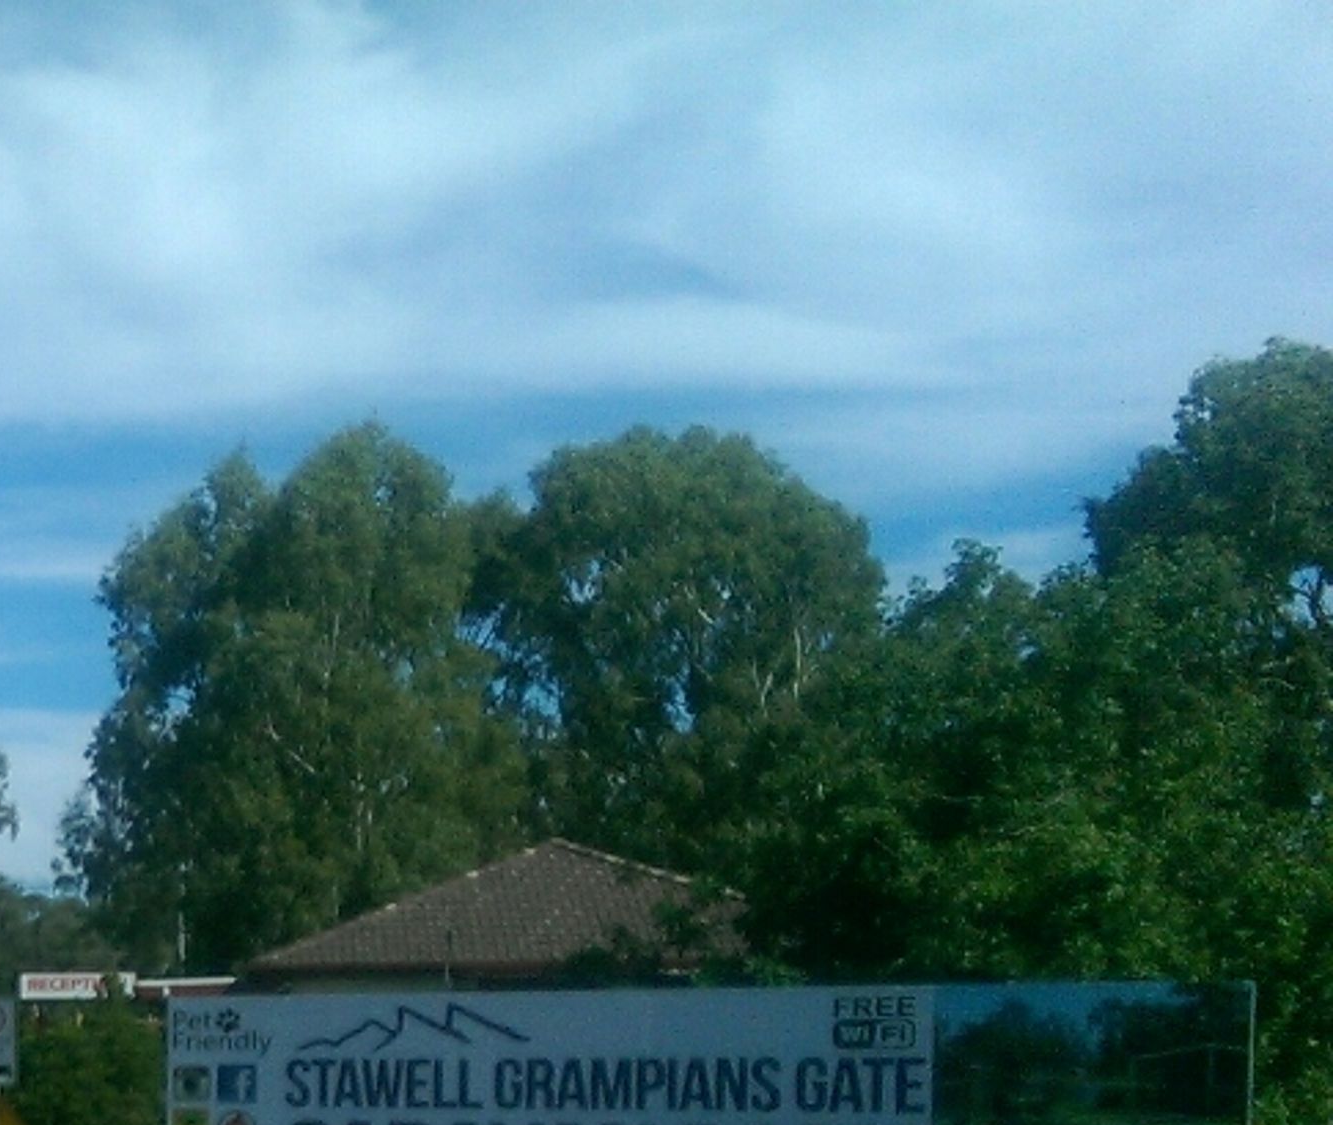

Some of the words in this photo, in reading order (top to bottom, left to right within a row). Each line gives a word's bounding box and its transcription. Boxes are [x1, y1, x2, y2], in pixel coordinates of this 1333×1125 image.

[834, 996, 916, 1017] FREE
[172, 1009, 214, 1029] Pet
[172, 1030, 272, 1056] Friendly
[285, 1057, 484, 1109] STAWELL
[493, 1057, 782, 1113] GRAMPIANS
[796, 1057, 926, 1114] GATE
